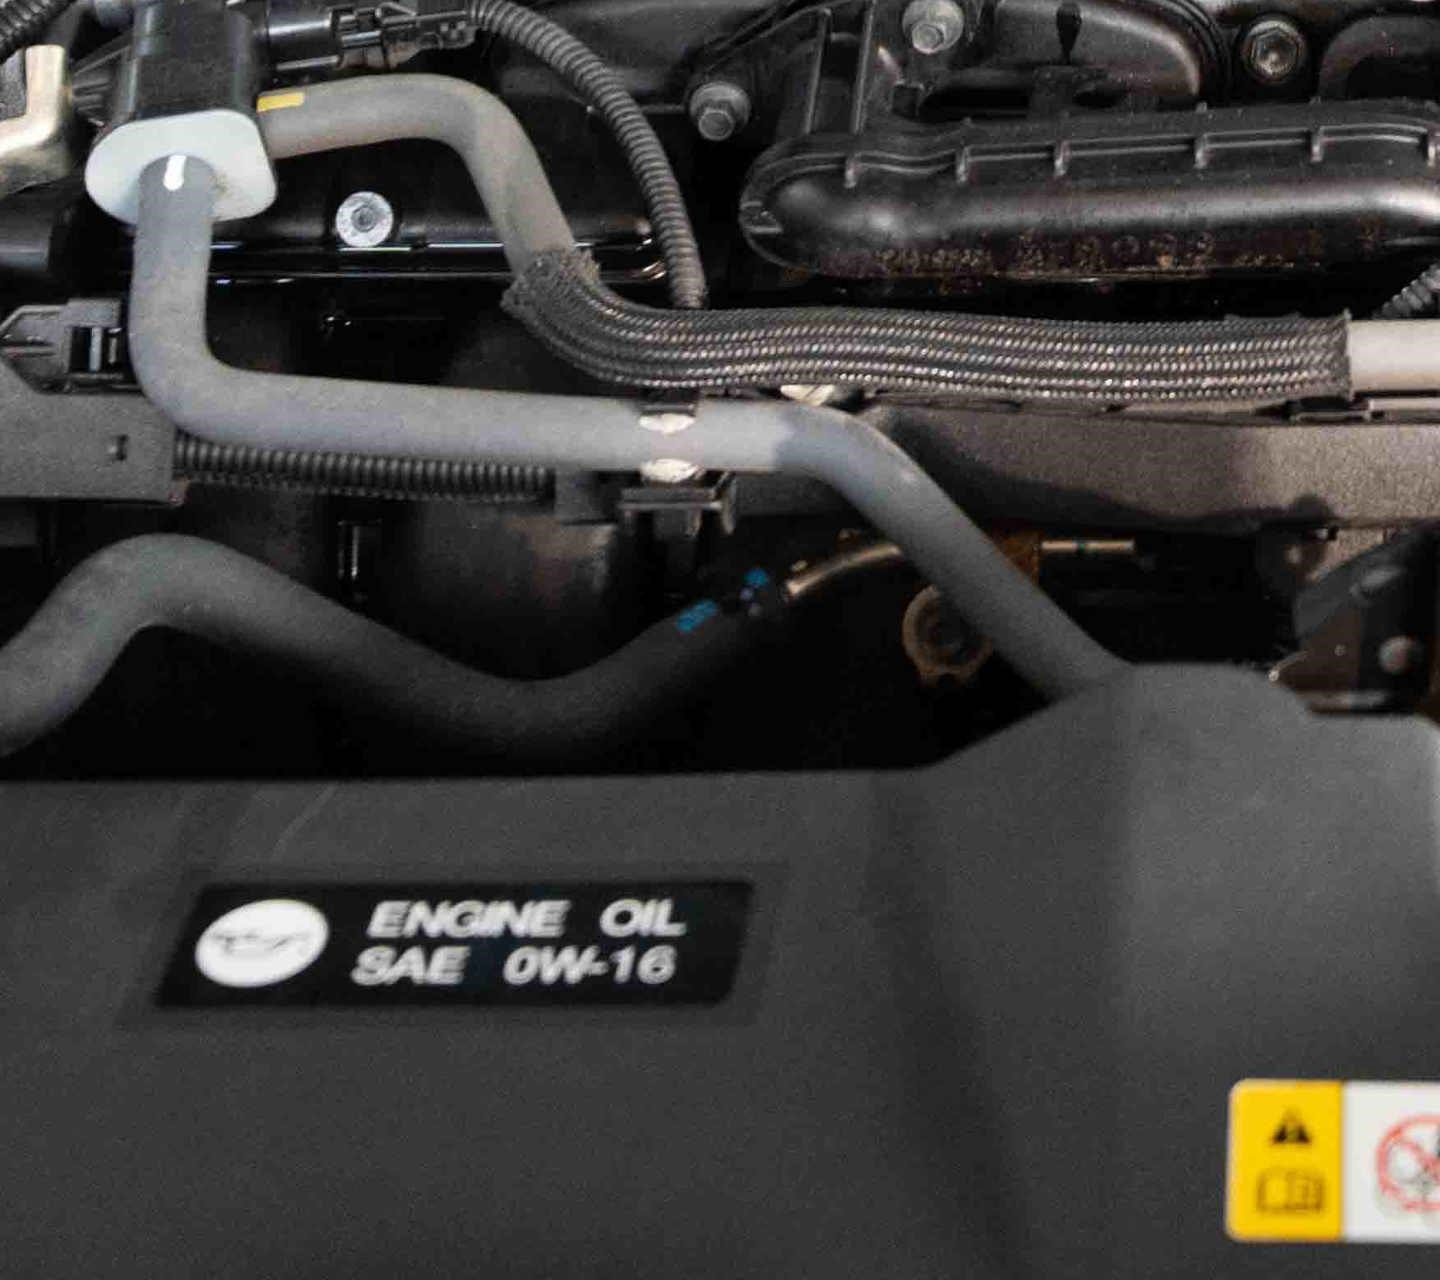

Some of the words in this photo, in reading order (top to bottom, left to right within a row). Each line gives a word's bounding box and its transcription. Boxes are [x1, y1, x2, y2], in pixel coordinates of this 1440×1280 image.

[366, 900, 572, 938] ENGINE
[599, 899, 687, 938] OIL
[351, 945, 471, 986] SAE
[502, 944, 679, 986] 0W-16
